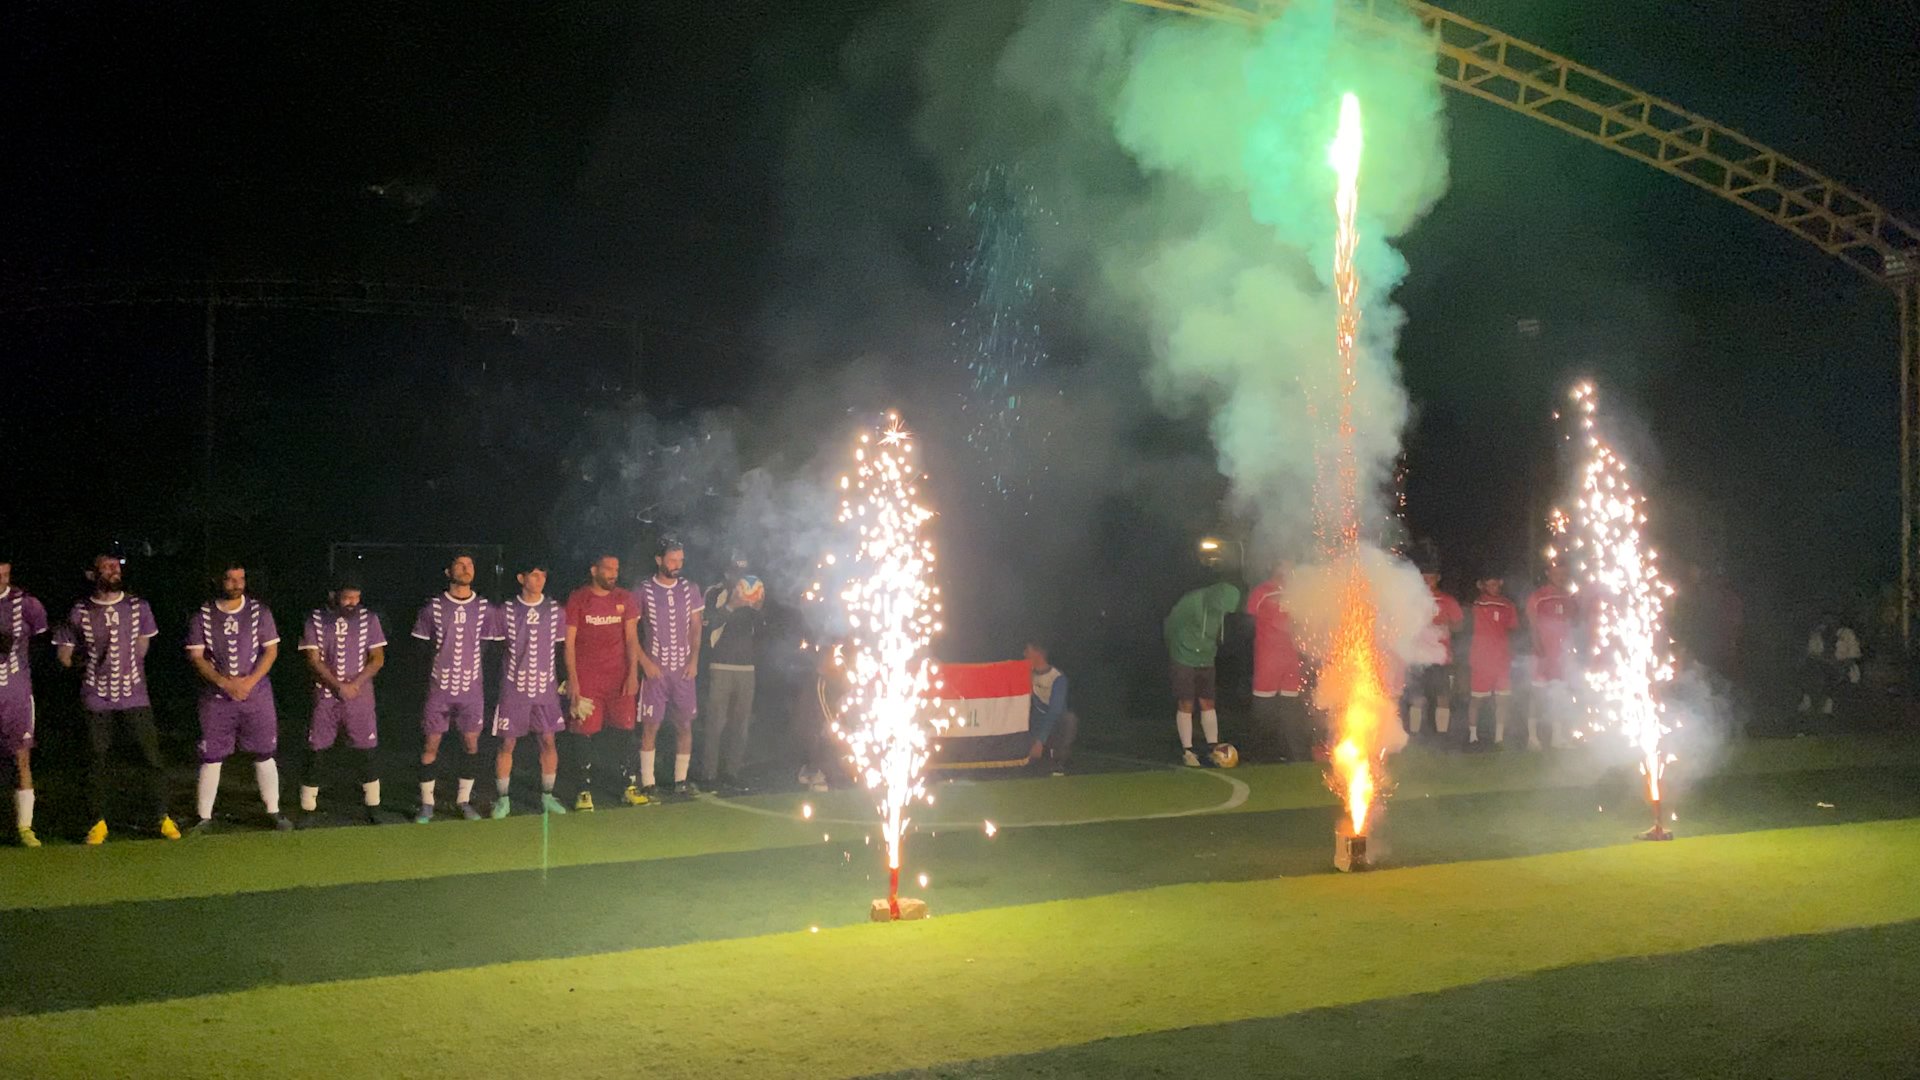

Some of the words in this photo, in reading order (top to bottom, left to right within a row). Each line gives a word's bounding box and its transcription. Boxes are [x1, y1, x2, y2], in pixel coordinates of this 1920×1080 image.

[104, 611, 120, 626] 14
[454, 611, 467, 624] 18
[527, 612, 540, 624] 22
[585, 615, 622, 625] Rakuten
[224, 621, 239, 635] 24
[335, 622, 348, 635] 12
[642, 704, 654, 717] 14
[498, 718, 510, 731] 22
